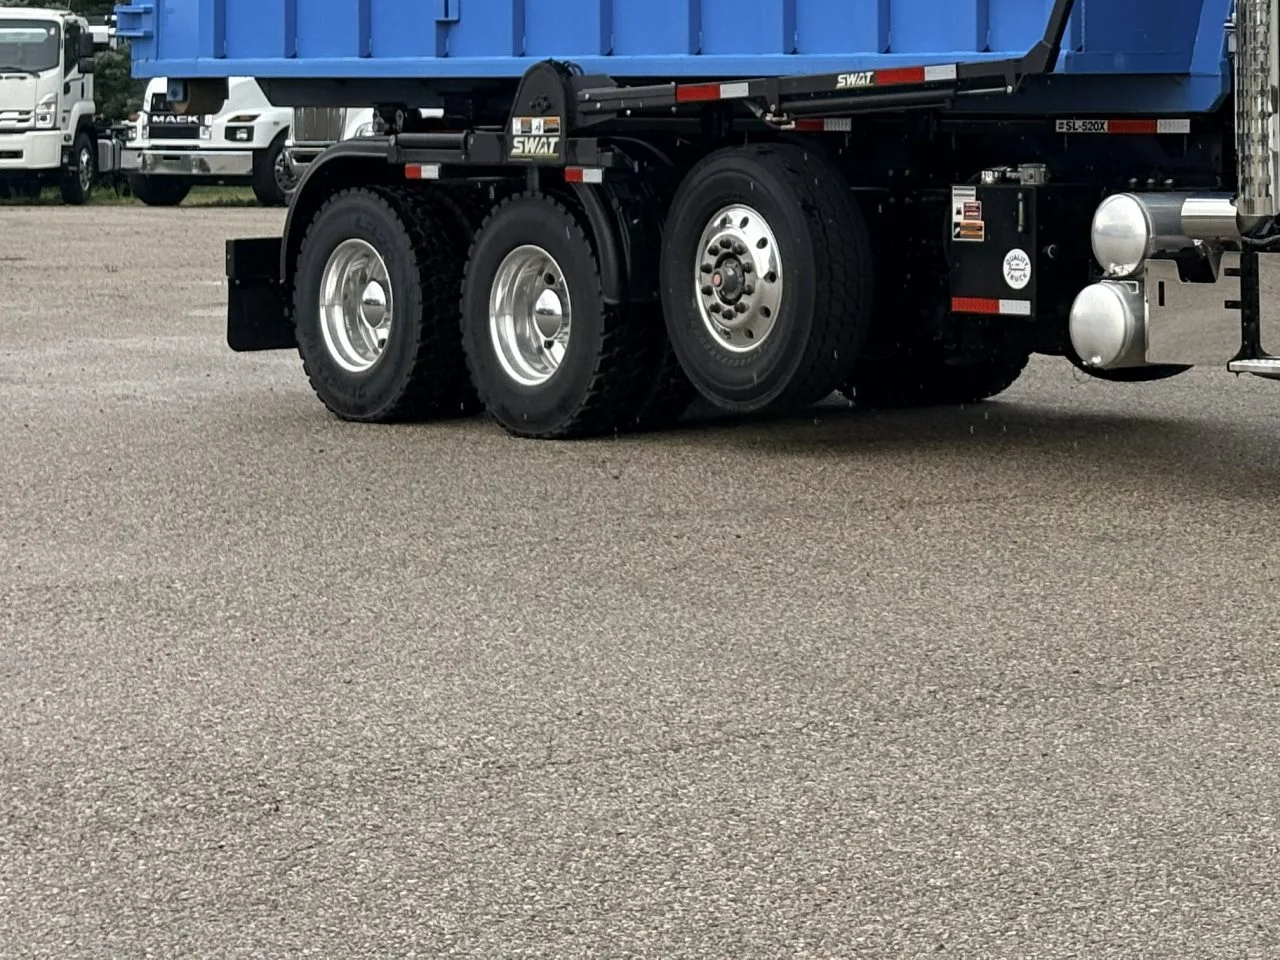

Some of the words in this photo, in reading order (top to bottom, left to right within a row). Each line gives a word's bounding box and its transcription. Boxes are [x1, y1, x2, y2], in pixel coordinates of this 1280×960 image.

[836, 71, 874, 89] SWAT
[152, 115, 199, 124] MACK
[511, 136, 560, 156] SWAT
